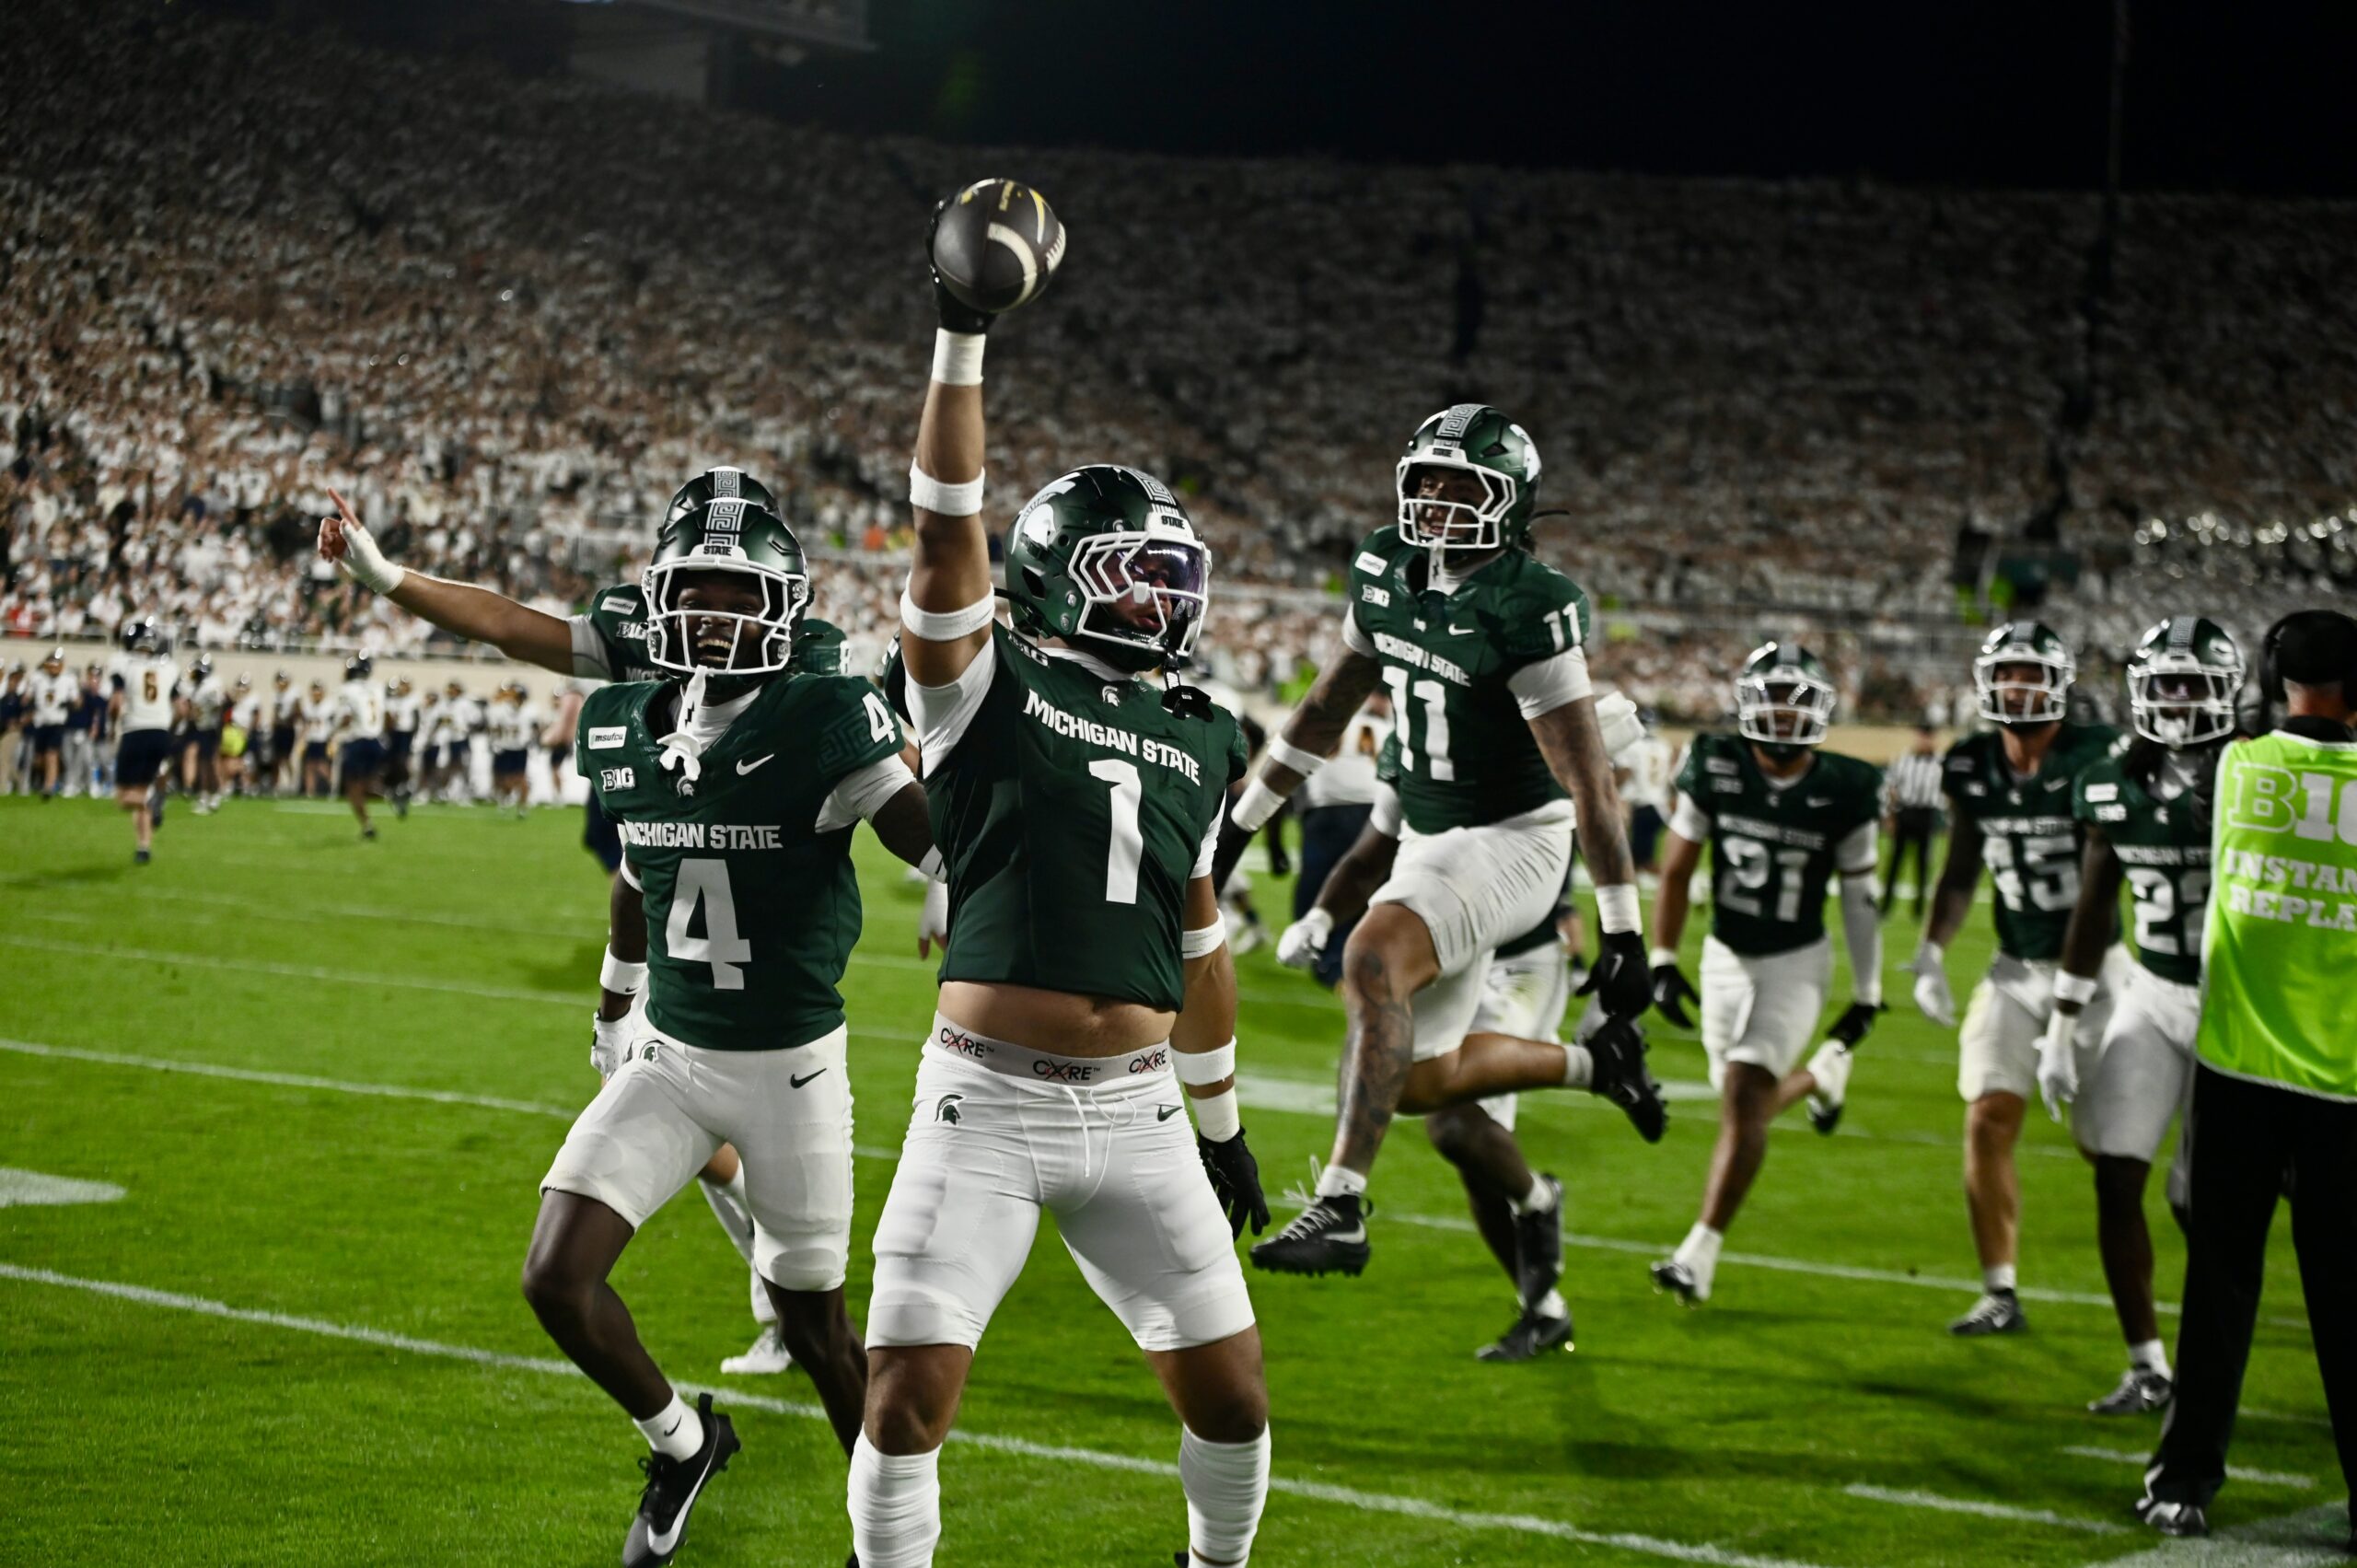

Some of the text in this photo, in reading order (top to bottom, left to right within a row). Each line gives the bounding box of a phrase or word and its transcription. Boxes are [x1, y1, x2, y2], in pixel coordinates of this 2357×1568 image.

[703, 545, 732, 556] STATE
[1161, 515, 1185, 529] STATE
[1543, 602, 1582, 652] 11
[862, 691, 897, 744] 4
[1024, 688, 1201, 786] MICHIGAN STATE
[1382, 665, 1455, 782] 11
[710, 824, 784, 850] STATE
[1088, 759, 1144, 905] 1
[1722, 835, 1811, 922] 21
[666, 858, 751, 990] 4
